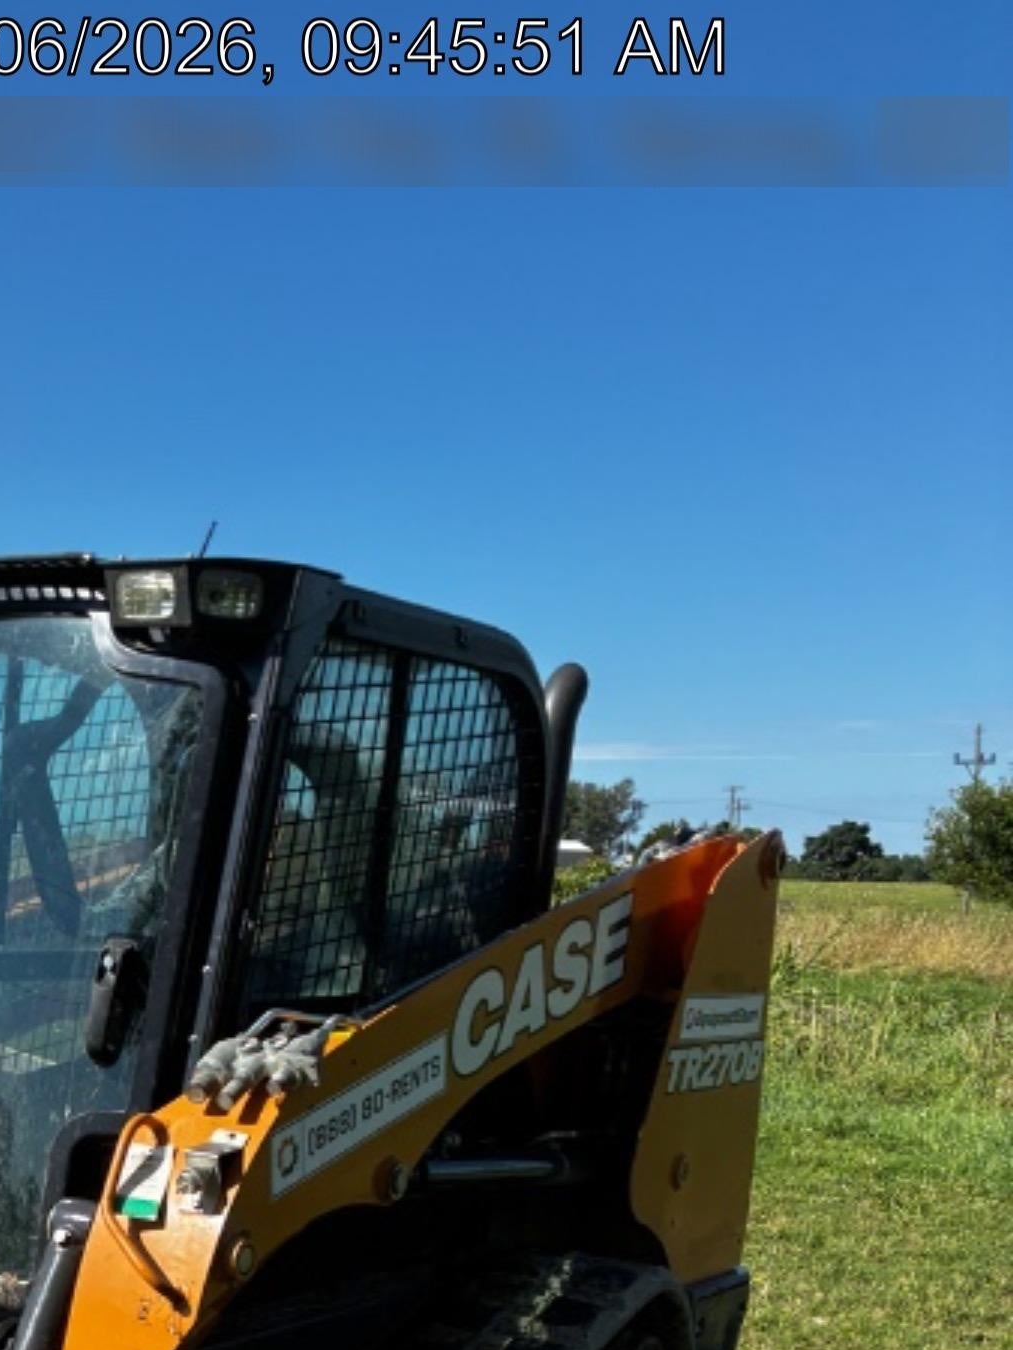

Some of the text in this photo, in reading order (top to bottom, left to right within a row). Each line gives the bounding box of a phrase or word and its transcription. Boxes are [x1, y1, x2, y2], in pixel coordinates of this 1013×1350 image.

[451, 893, 634, 1076] CASE
[360, 1054, 442, 1121] 80-RENTS
[667, 1040, 762, 1093] TR270B
